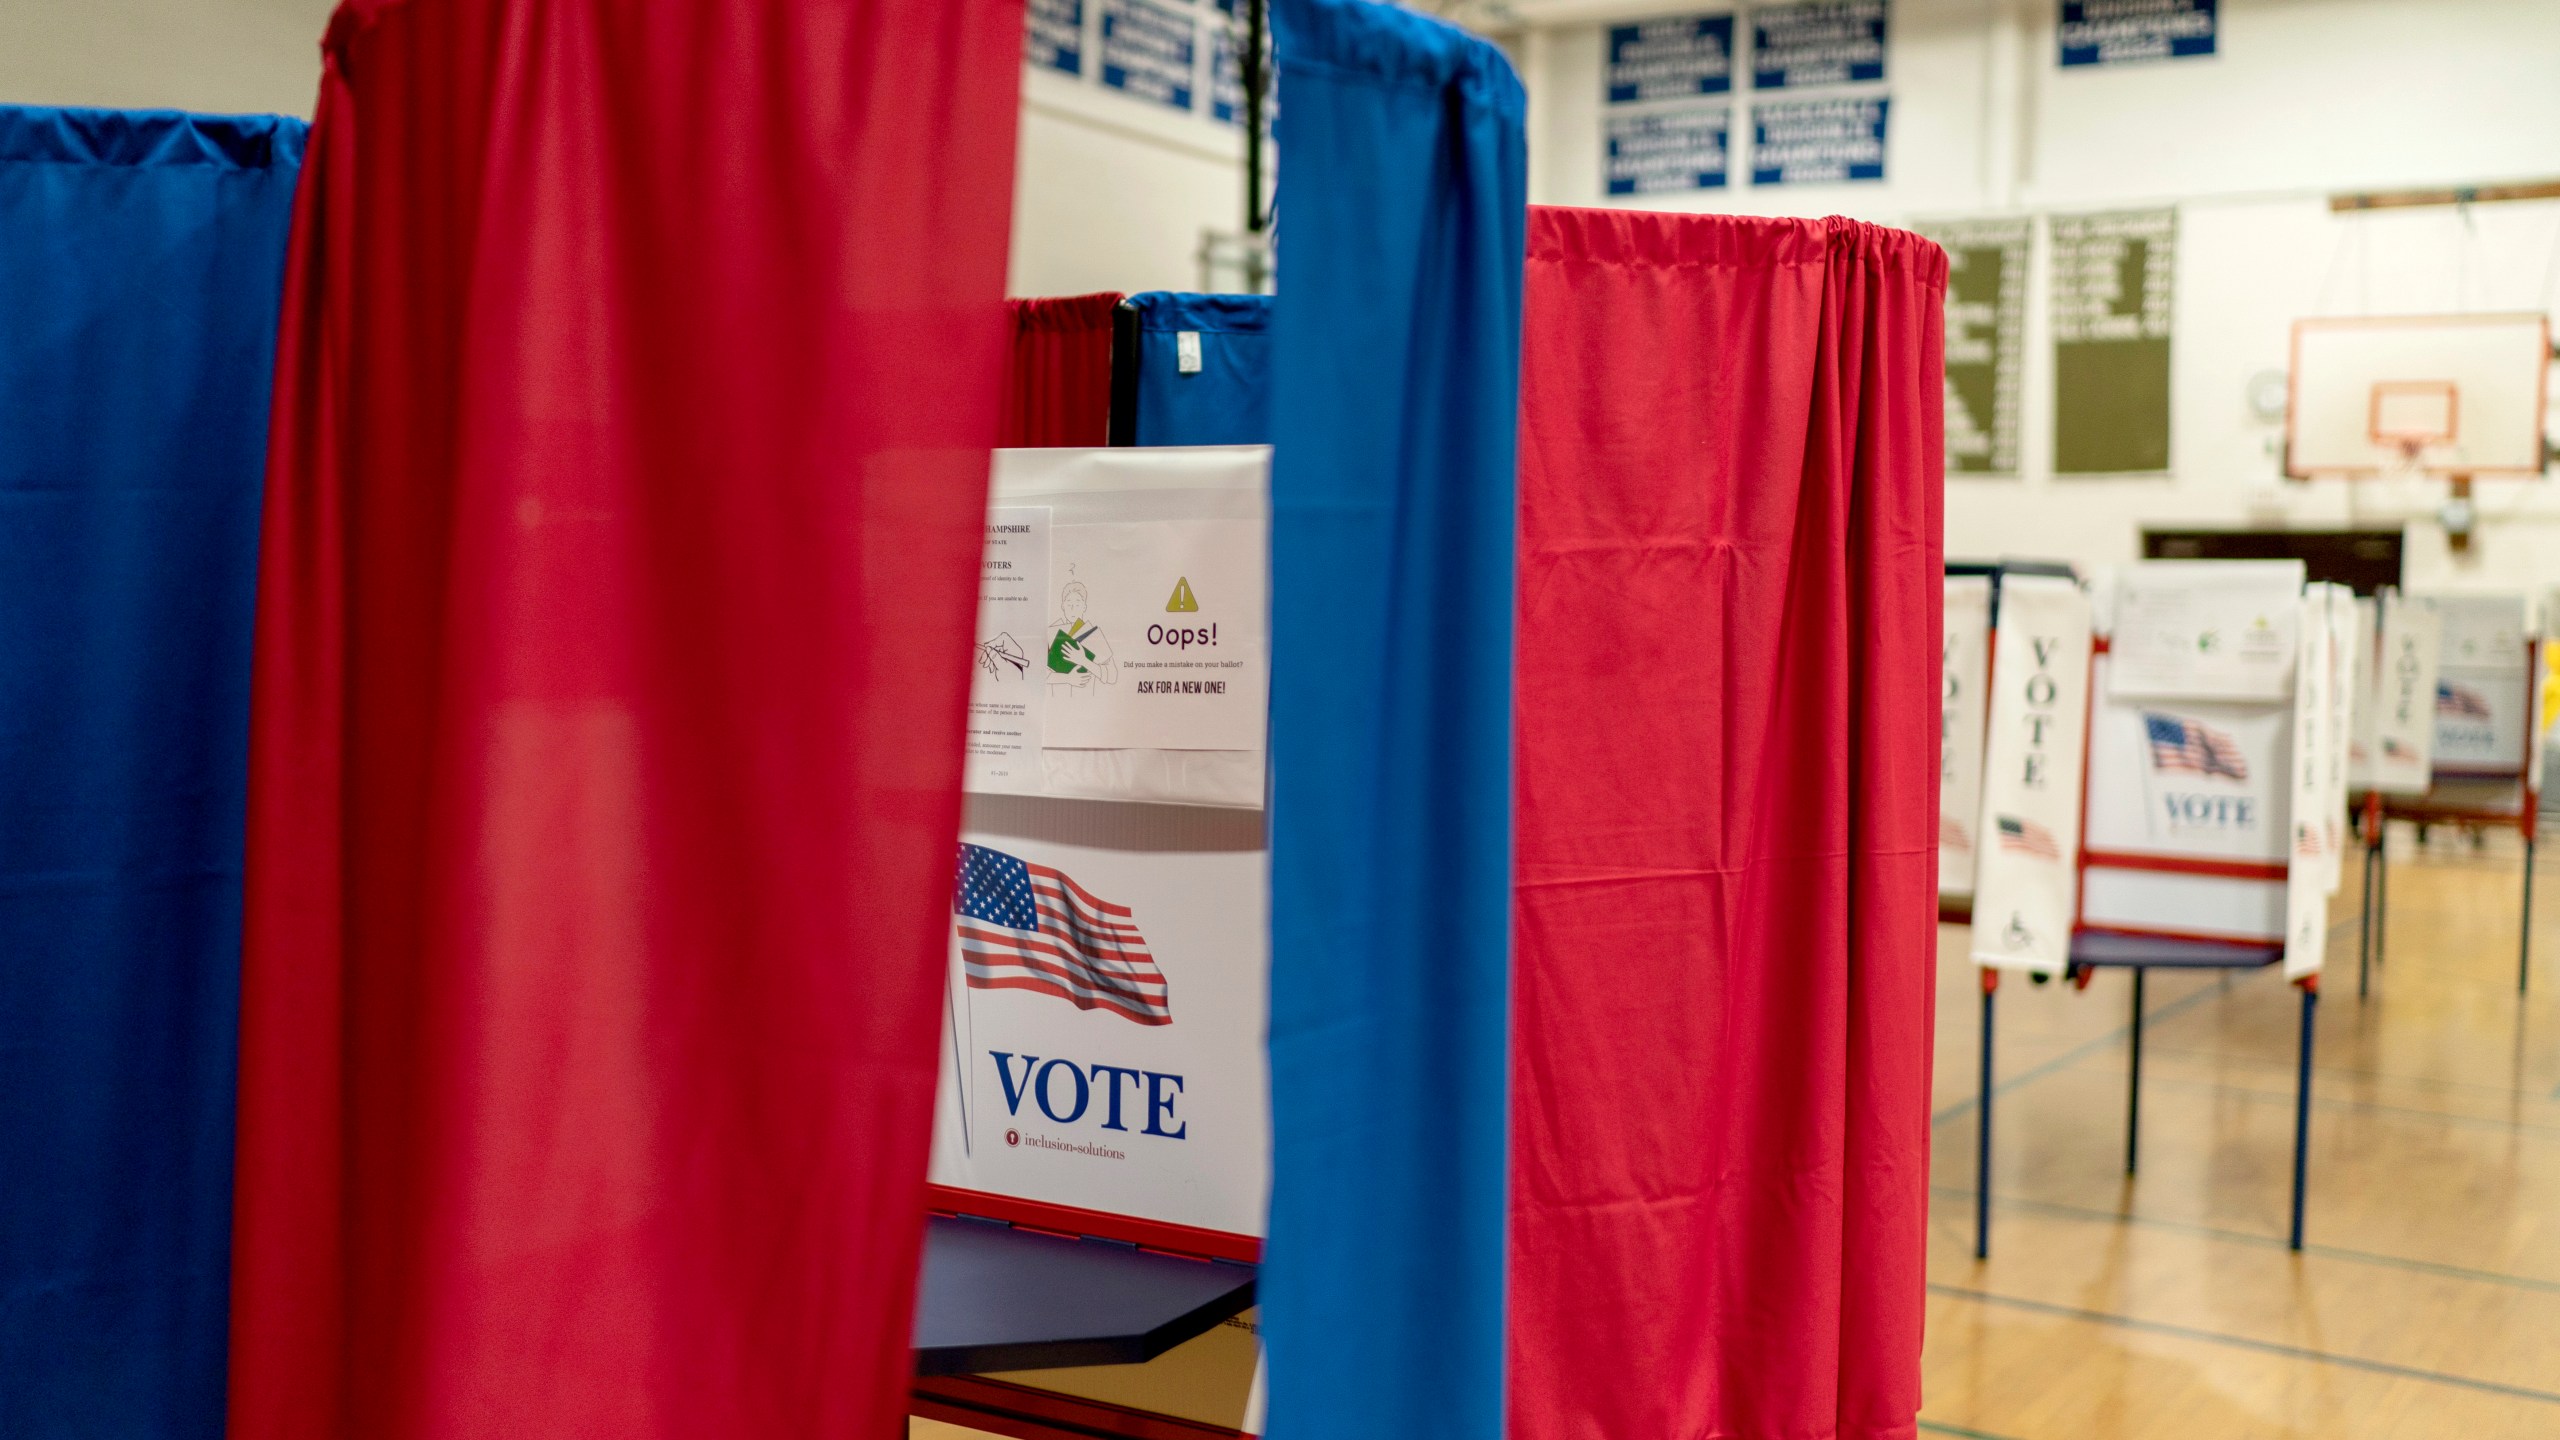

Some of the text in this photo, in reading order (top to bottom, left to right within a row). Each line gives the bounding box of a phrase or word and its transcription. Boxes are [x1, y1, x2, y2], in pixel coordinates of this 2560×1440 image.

[985, 525, 1031, 534] HAMPSHIRE
[981, 561, 1012, 569] VOTERS
[1147, 622, 1217, 650] Oops!
[1137, 681, 1226, 694] ASK FOR A NEW ONE!
[2023, 635, 2059, 788] VOTE
[2163, 791, 2258, 830] VOTE
[988, 1050, 1186, 1140] VOTE
